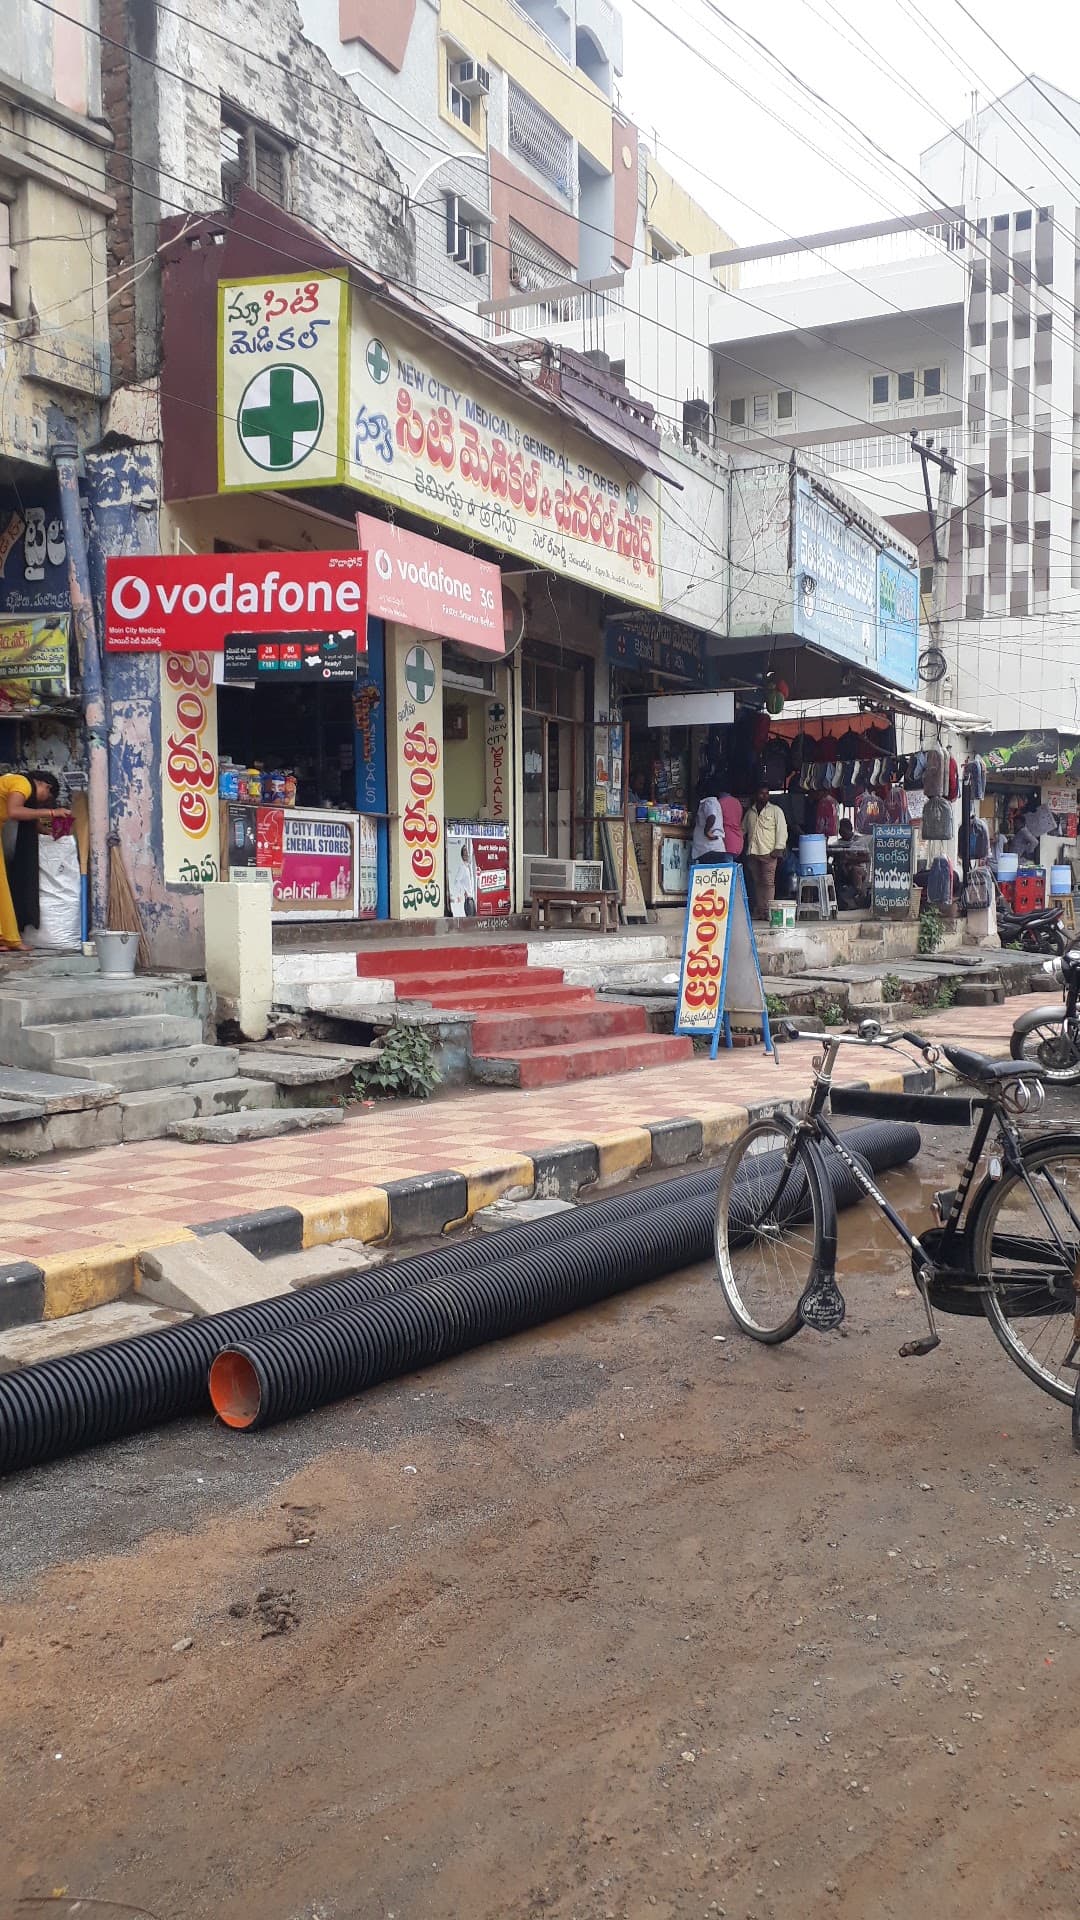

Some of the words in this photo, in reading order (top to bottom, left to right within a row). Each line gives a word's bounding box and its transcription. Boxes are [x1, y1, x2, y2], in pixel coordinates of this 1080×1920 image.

[228, 292, 261, 326] న్యూ
[229, 320, 331, 355] మెడికల్
[397, 360, 425, 393] NEW
[428, 379, 461, 411] CITY
[465, 399, 513, 442] MEDICAL
[514, 428, 521, 446] &
[523, 434, 574, 476] GENERAL
[577, 464, 621, 499] STORES
[355, 404, 394, 463] న్యూ
[459, 419, 541, 515] మెడికల్
[540, 486, 551, 519] &
[554, 480, 617, 549] జనరల్
[156, 571, 362, 614] vodafone
[397, 559, 472, 602] vodafone
[479, 587, 495, 610] 3G
[125, 626, 137, 636] City
[138, 626, 166, 635] Medicals
[487, 733, 508, 747] CITY
[488, 723, 507, 733] NEW
[491, 747, 503, 817] MEDICALS
[286, 838, 317, 853] ENERAL
[318, 840, 349, 854] STORES
[292, 822, 312, 837] CITY
[313, 824, 349, 839] MEDICAL
[481, 873, 498, 885] nise
